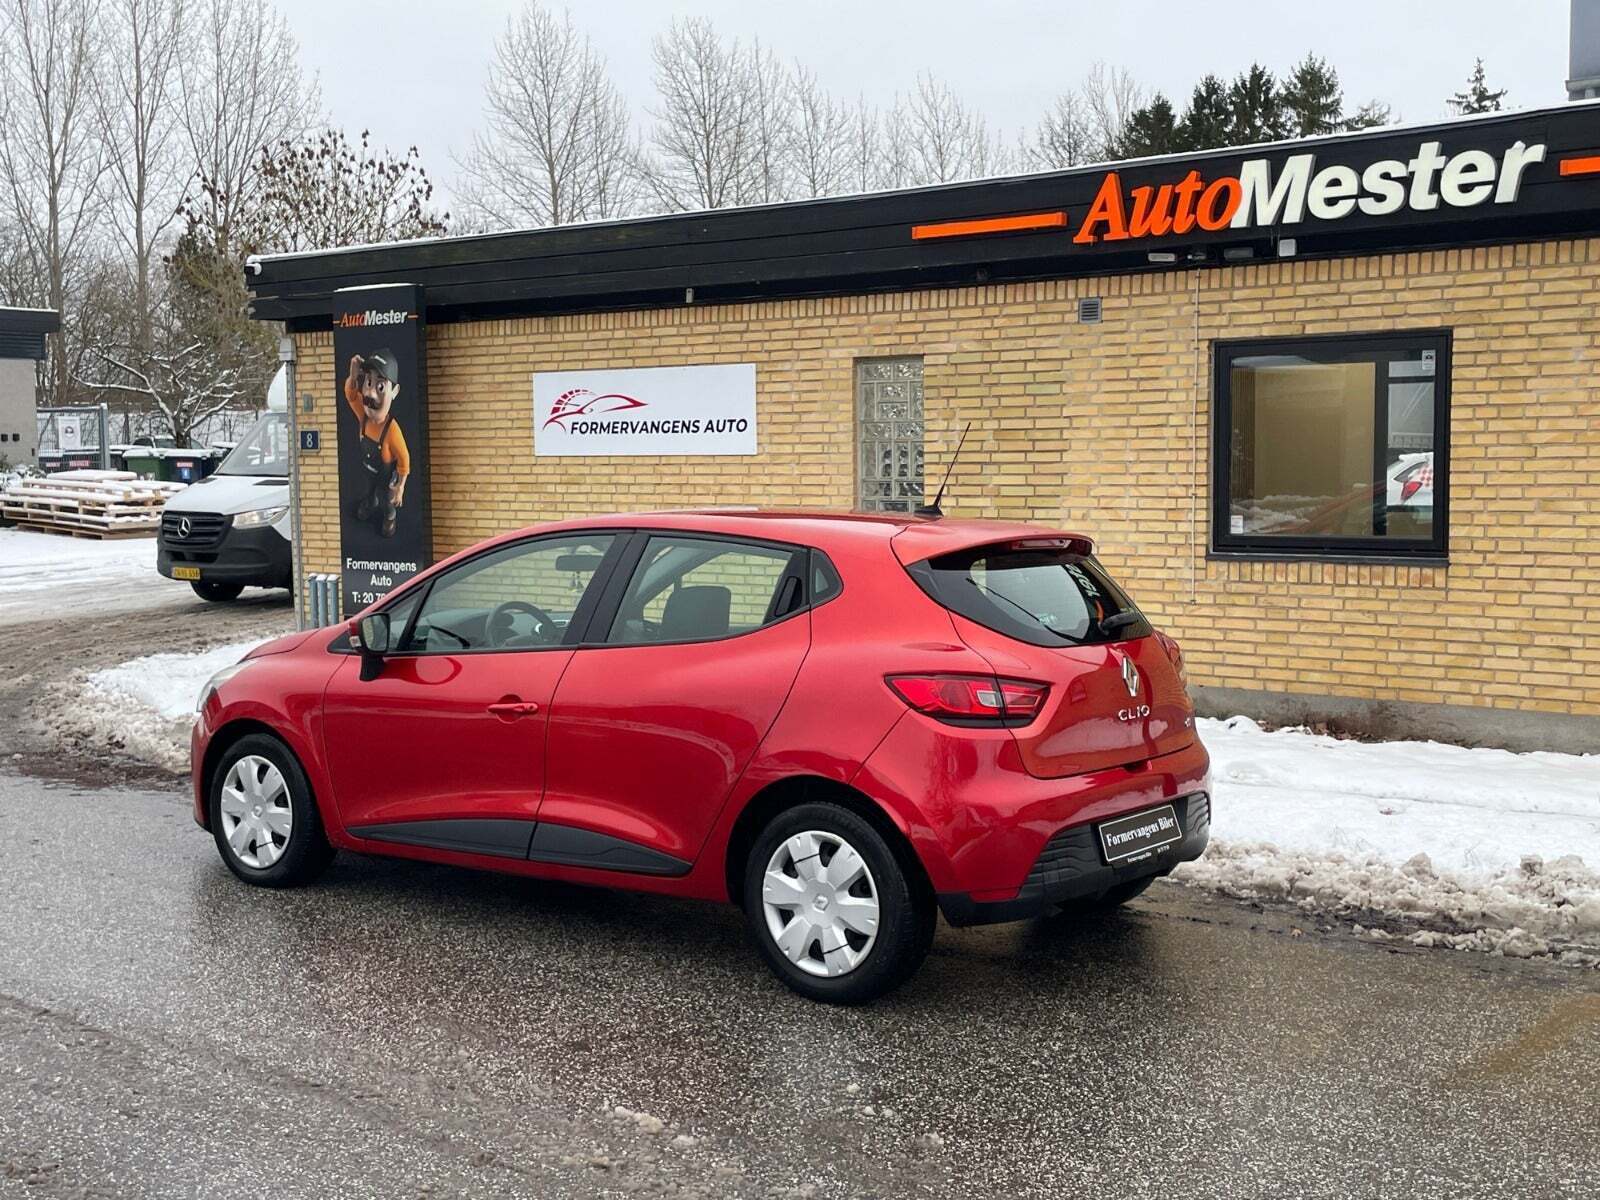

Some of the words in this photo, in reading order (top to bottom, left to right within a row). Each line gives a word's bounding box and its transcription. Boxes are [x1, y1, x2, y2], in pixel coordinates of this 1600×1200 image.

[1073, 140, 1547, 244] AutoMester
[340, 309, 408, 327] AutoMester
[570, 419, 701, 435] FORMERVANGENS
[704, 418, 748, 433] AUTO
[306, 432, 313, 448] 8
[346, 558, 417, 574] Formervangens
[370, 574, 393, 586] Auto
[352, 591, 361, 603] T:
[363, 592, 374, 603] 20
